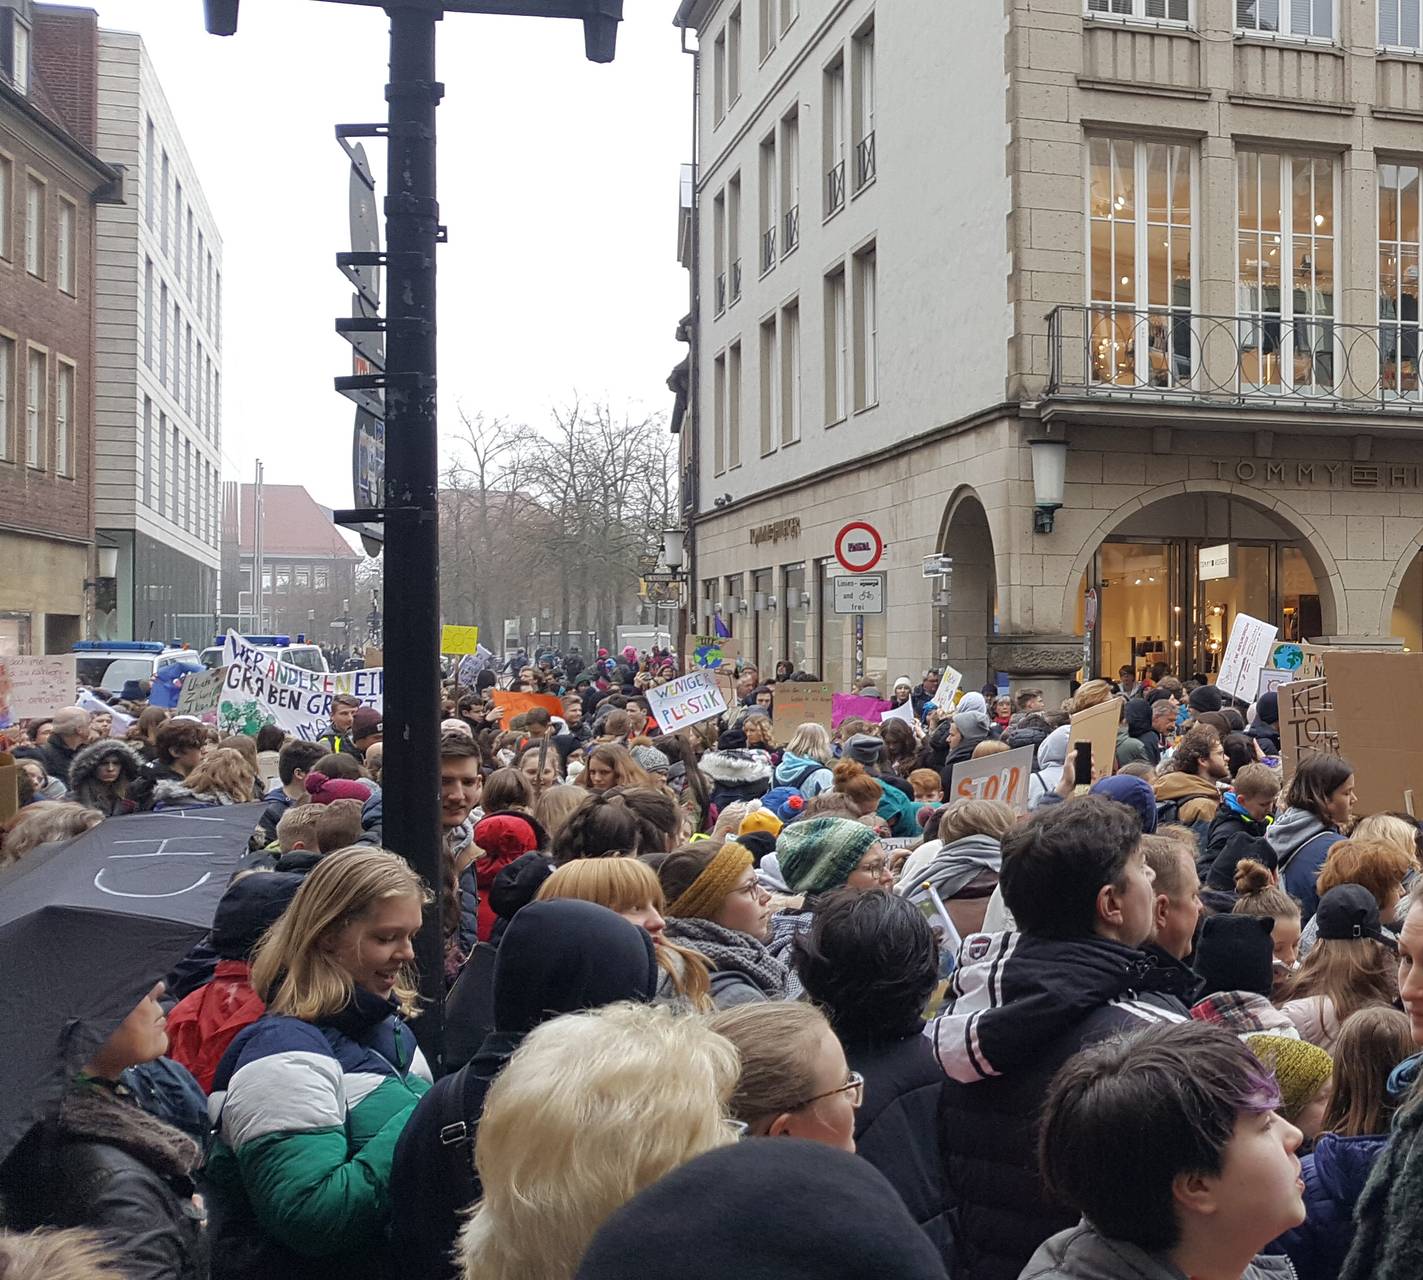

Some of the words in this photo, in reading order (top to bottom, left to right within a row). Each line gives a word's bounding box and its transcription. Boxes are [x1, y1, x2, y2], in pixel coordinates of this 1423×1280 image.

[1212, 459, 1341, 484] TOMMY
[851, 603, 865, 611] frei
[231, 635, 265, 674] WER
[264, 658, 350, 696] ANDEREN
[654, 673, 712, 699] WENIGER
[661, 690, 720, 726] PLASTIK
